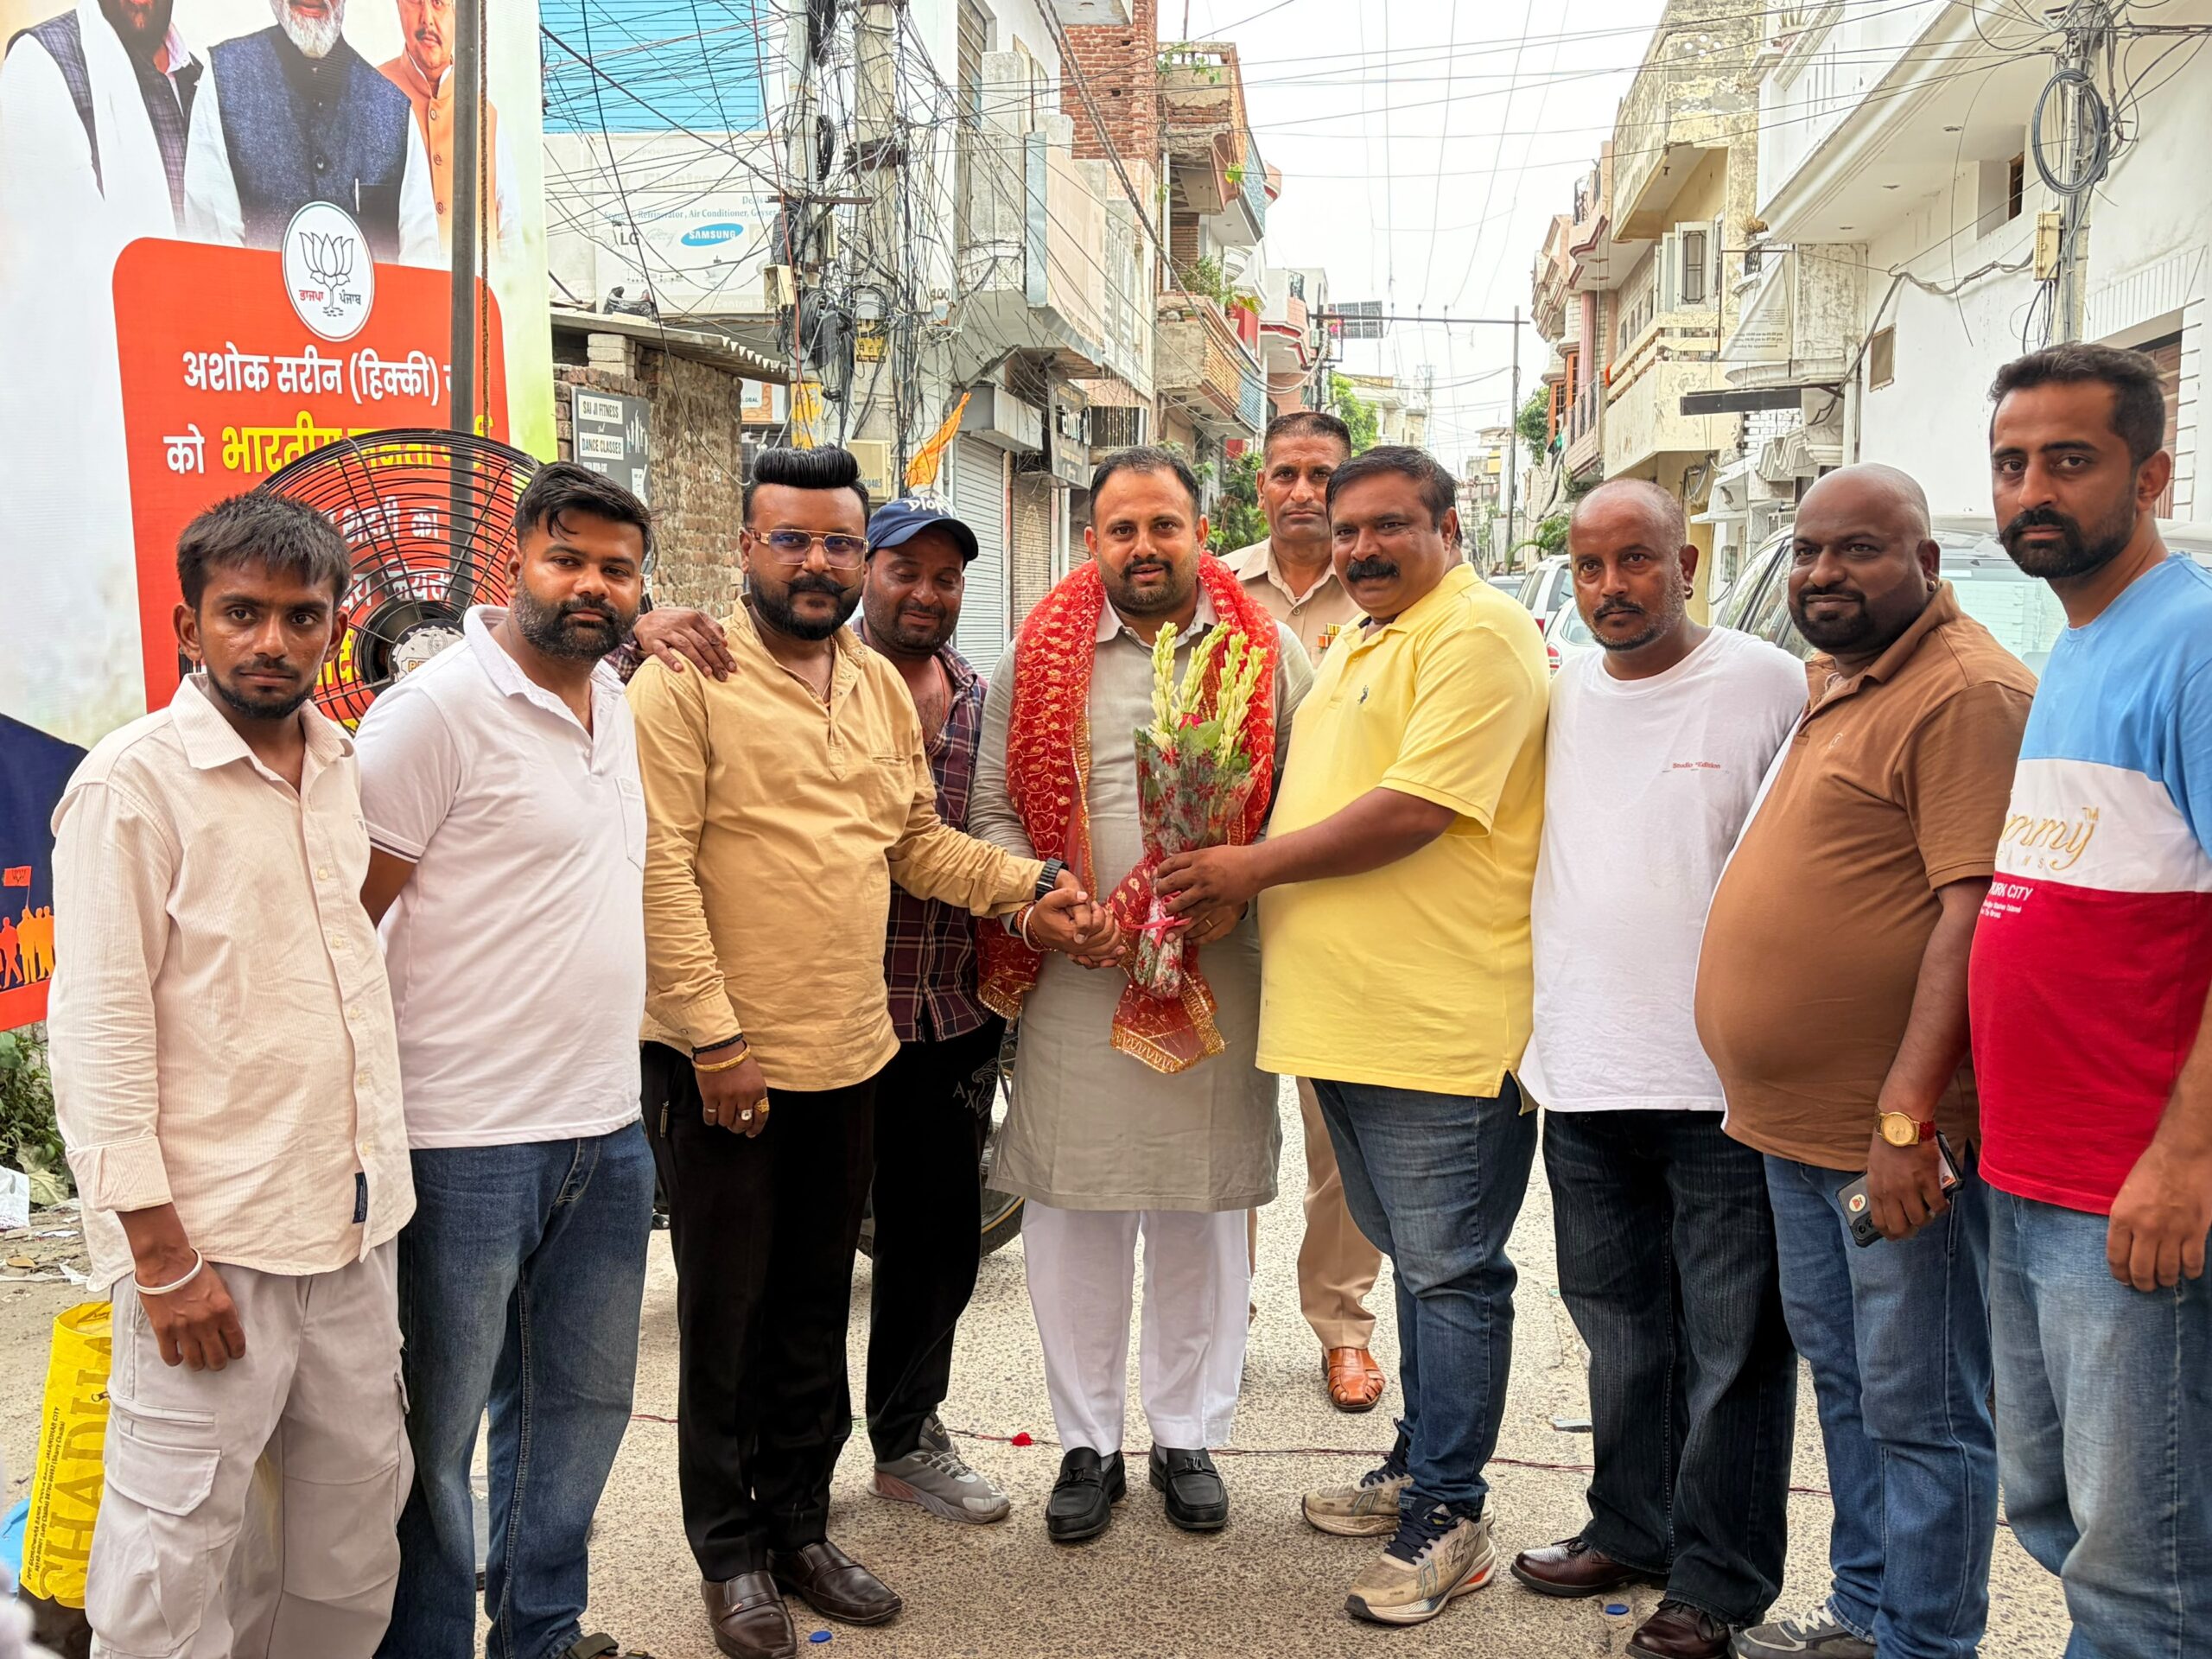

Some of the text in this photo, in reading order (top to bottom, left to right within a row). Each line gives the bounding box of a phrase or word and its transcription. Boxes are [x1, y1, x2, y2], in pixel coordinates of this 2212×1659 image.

[620, 232, 639, 245] LG
[689, 230, 736, 239] SAMSUNG
[182, 341, 270, 391] अशोक
[273, 345, 343, 394] सरीन
[349, 346, 440, 405] (हिक्की)
[582, 401, 620, 419] SAI JI FITNESS
[163, 423, 206, 474] को
[582, 438, 621, 454] DANCE CLASSES
[2002, 814, 2094, 871] mmy
[2007, 884, 2034, 901] CITY
